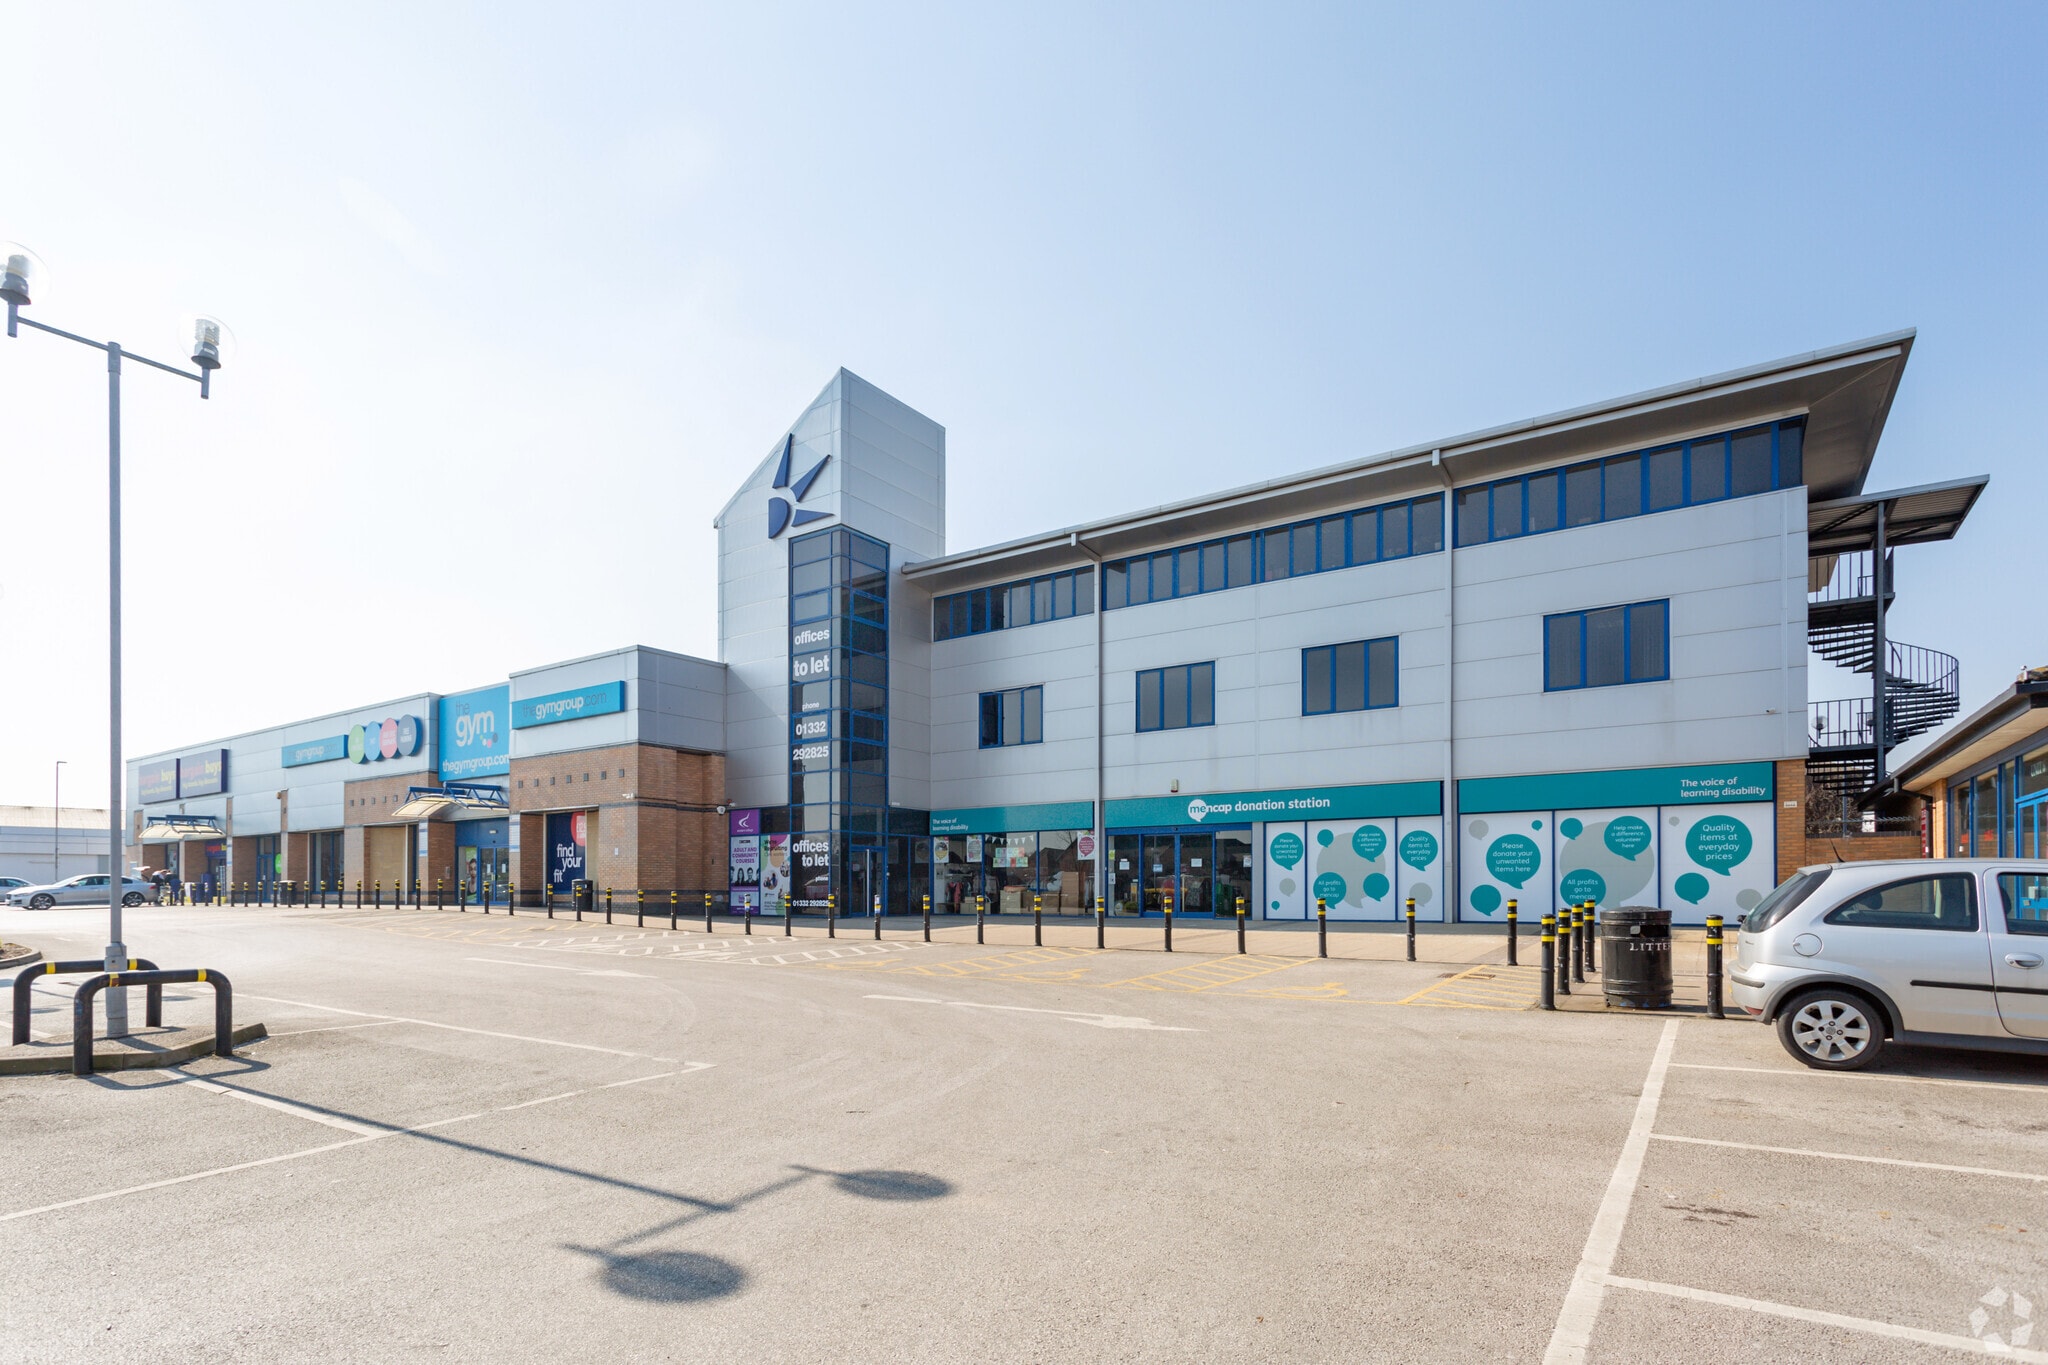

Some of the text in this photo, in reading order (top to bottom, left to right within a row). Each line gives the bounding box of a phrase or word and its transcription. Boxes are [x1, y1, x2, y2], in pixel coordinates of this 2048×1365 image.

[794, 628, 830, 646] offices
[794, 654, 829, 677] to let
[455, 697, 470, 716] the
[522, 692, 607, 720] thegymgroup.com
[802, 702, 819, 711] phone
[455, 710, 495, 747] gym
[796, 721, 826, 736] 01332
[792, 746, 829, 761] 292825
[1680, 776, 1738, 787] The voice of
[1680, 787, 1766, 798] learning disability
[1189, 797, 1330, 814] mencap donation station
[1702, 824, 1735, 833] Quality
[1700, 833, 1726, 841] items
[556, 842, 574, 857] find
[792, 839, 829, 853] offices
[1698, 843, 1740, 852] everyday
[801, 853, 829, 867] to let
[1518, 850, 1533, 858] your
[1705, 852, 1733, 861] prices
[561, 856, 582, 872] your
[553, 868, 563, 883] fit
